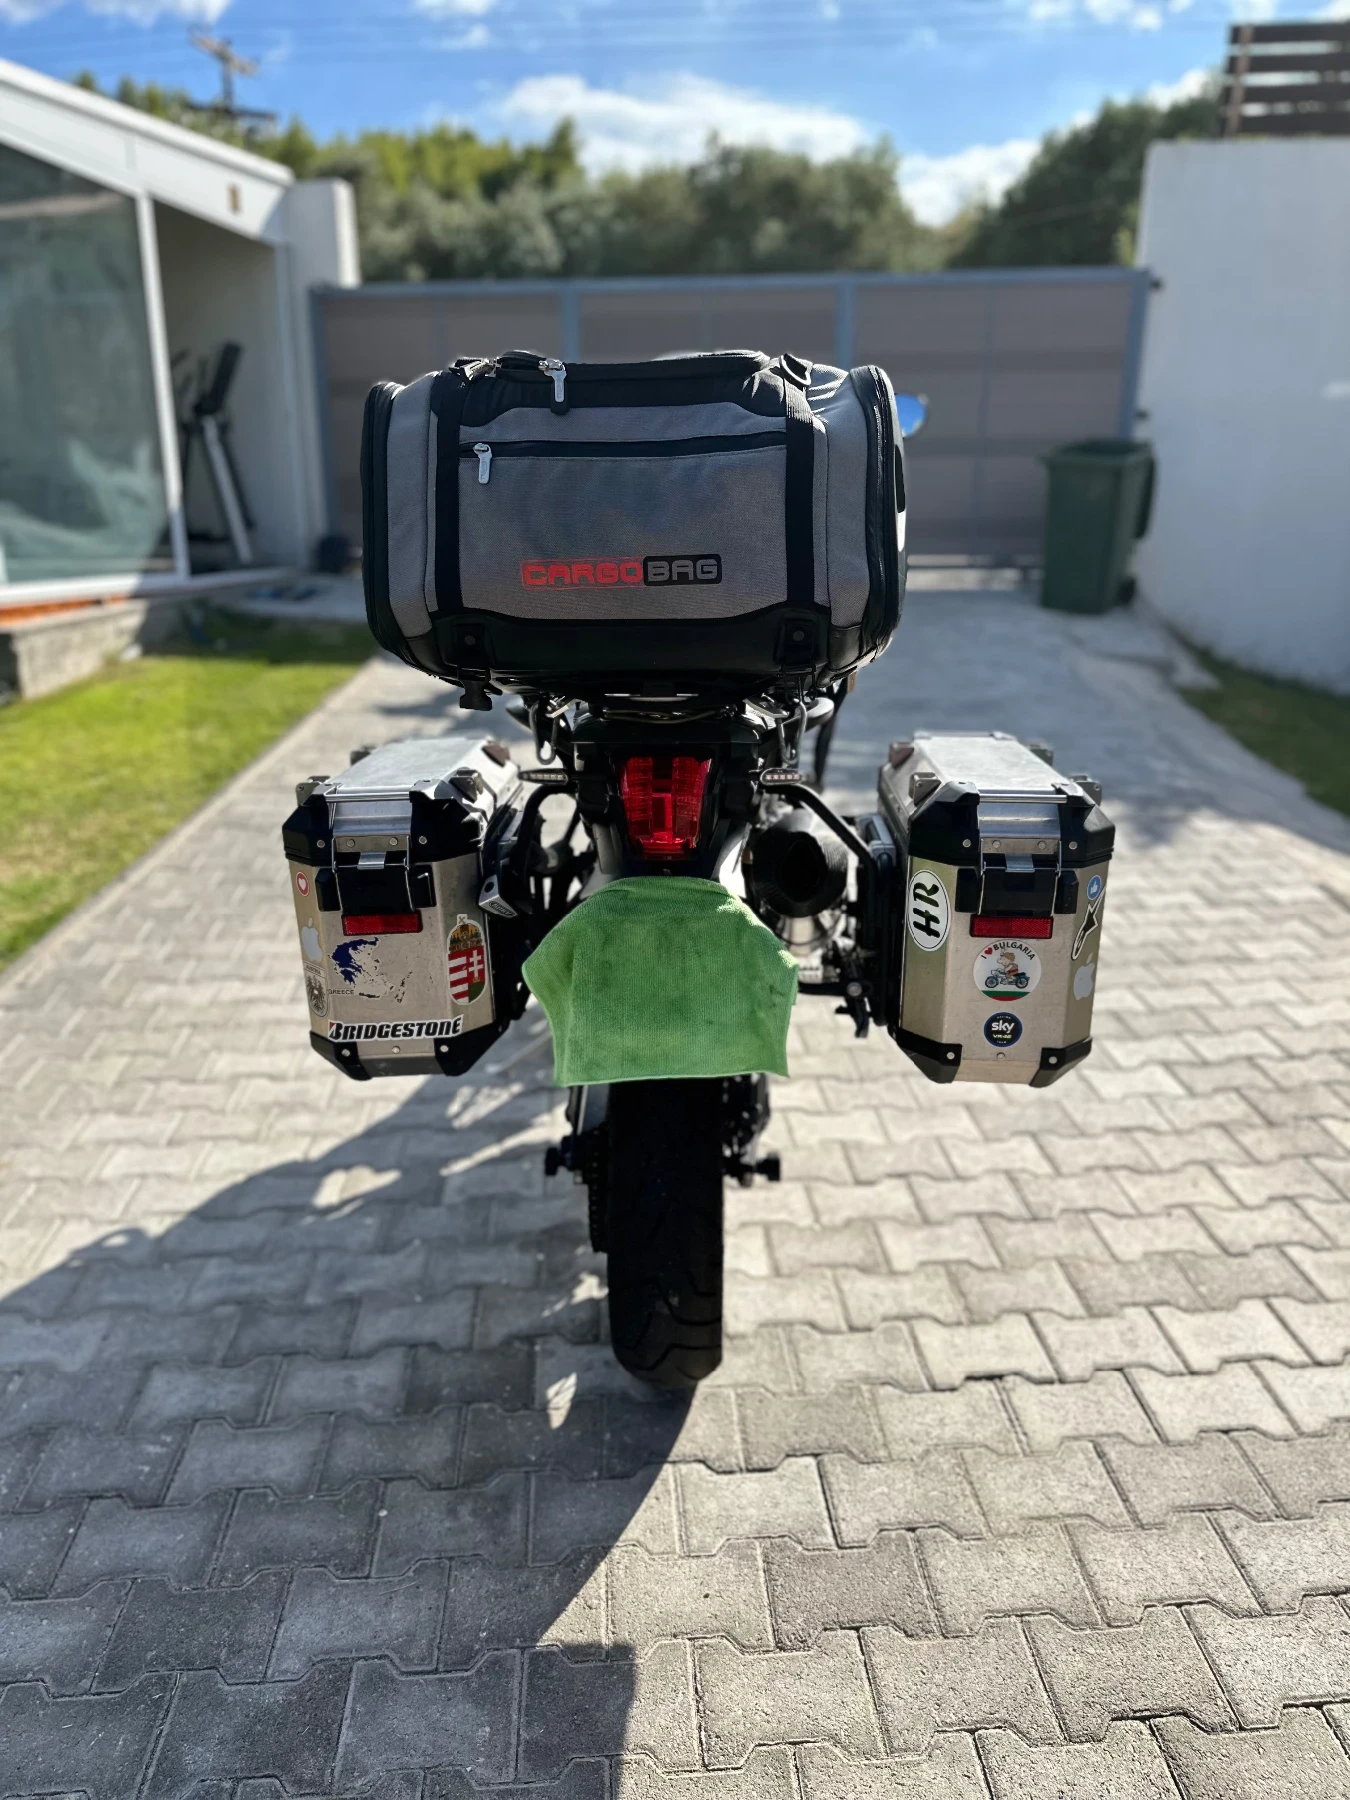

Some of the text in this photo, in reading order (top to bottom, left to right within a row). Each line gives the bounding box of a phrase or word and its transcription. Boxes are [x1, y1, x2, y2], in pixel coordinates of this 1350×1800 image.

[912, 882, 940, 938] HR
[992, 941, 1036, 961] BULGARIA
[328, 1016, 462, 1040] BRIDGESTONE
[991, 1019, 1015, 1034] sky
